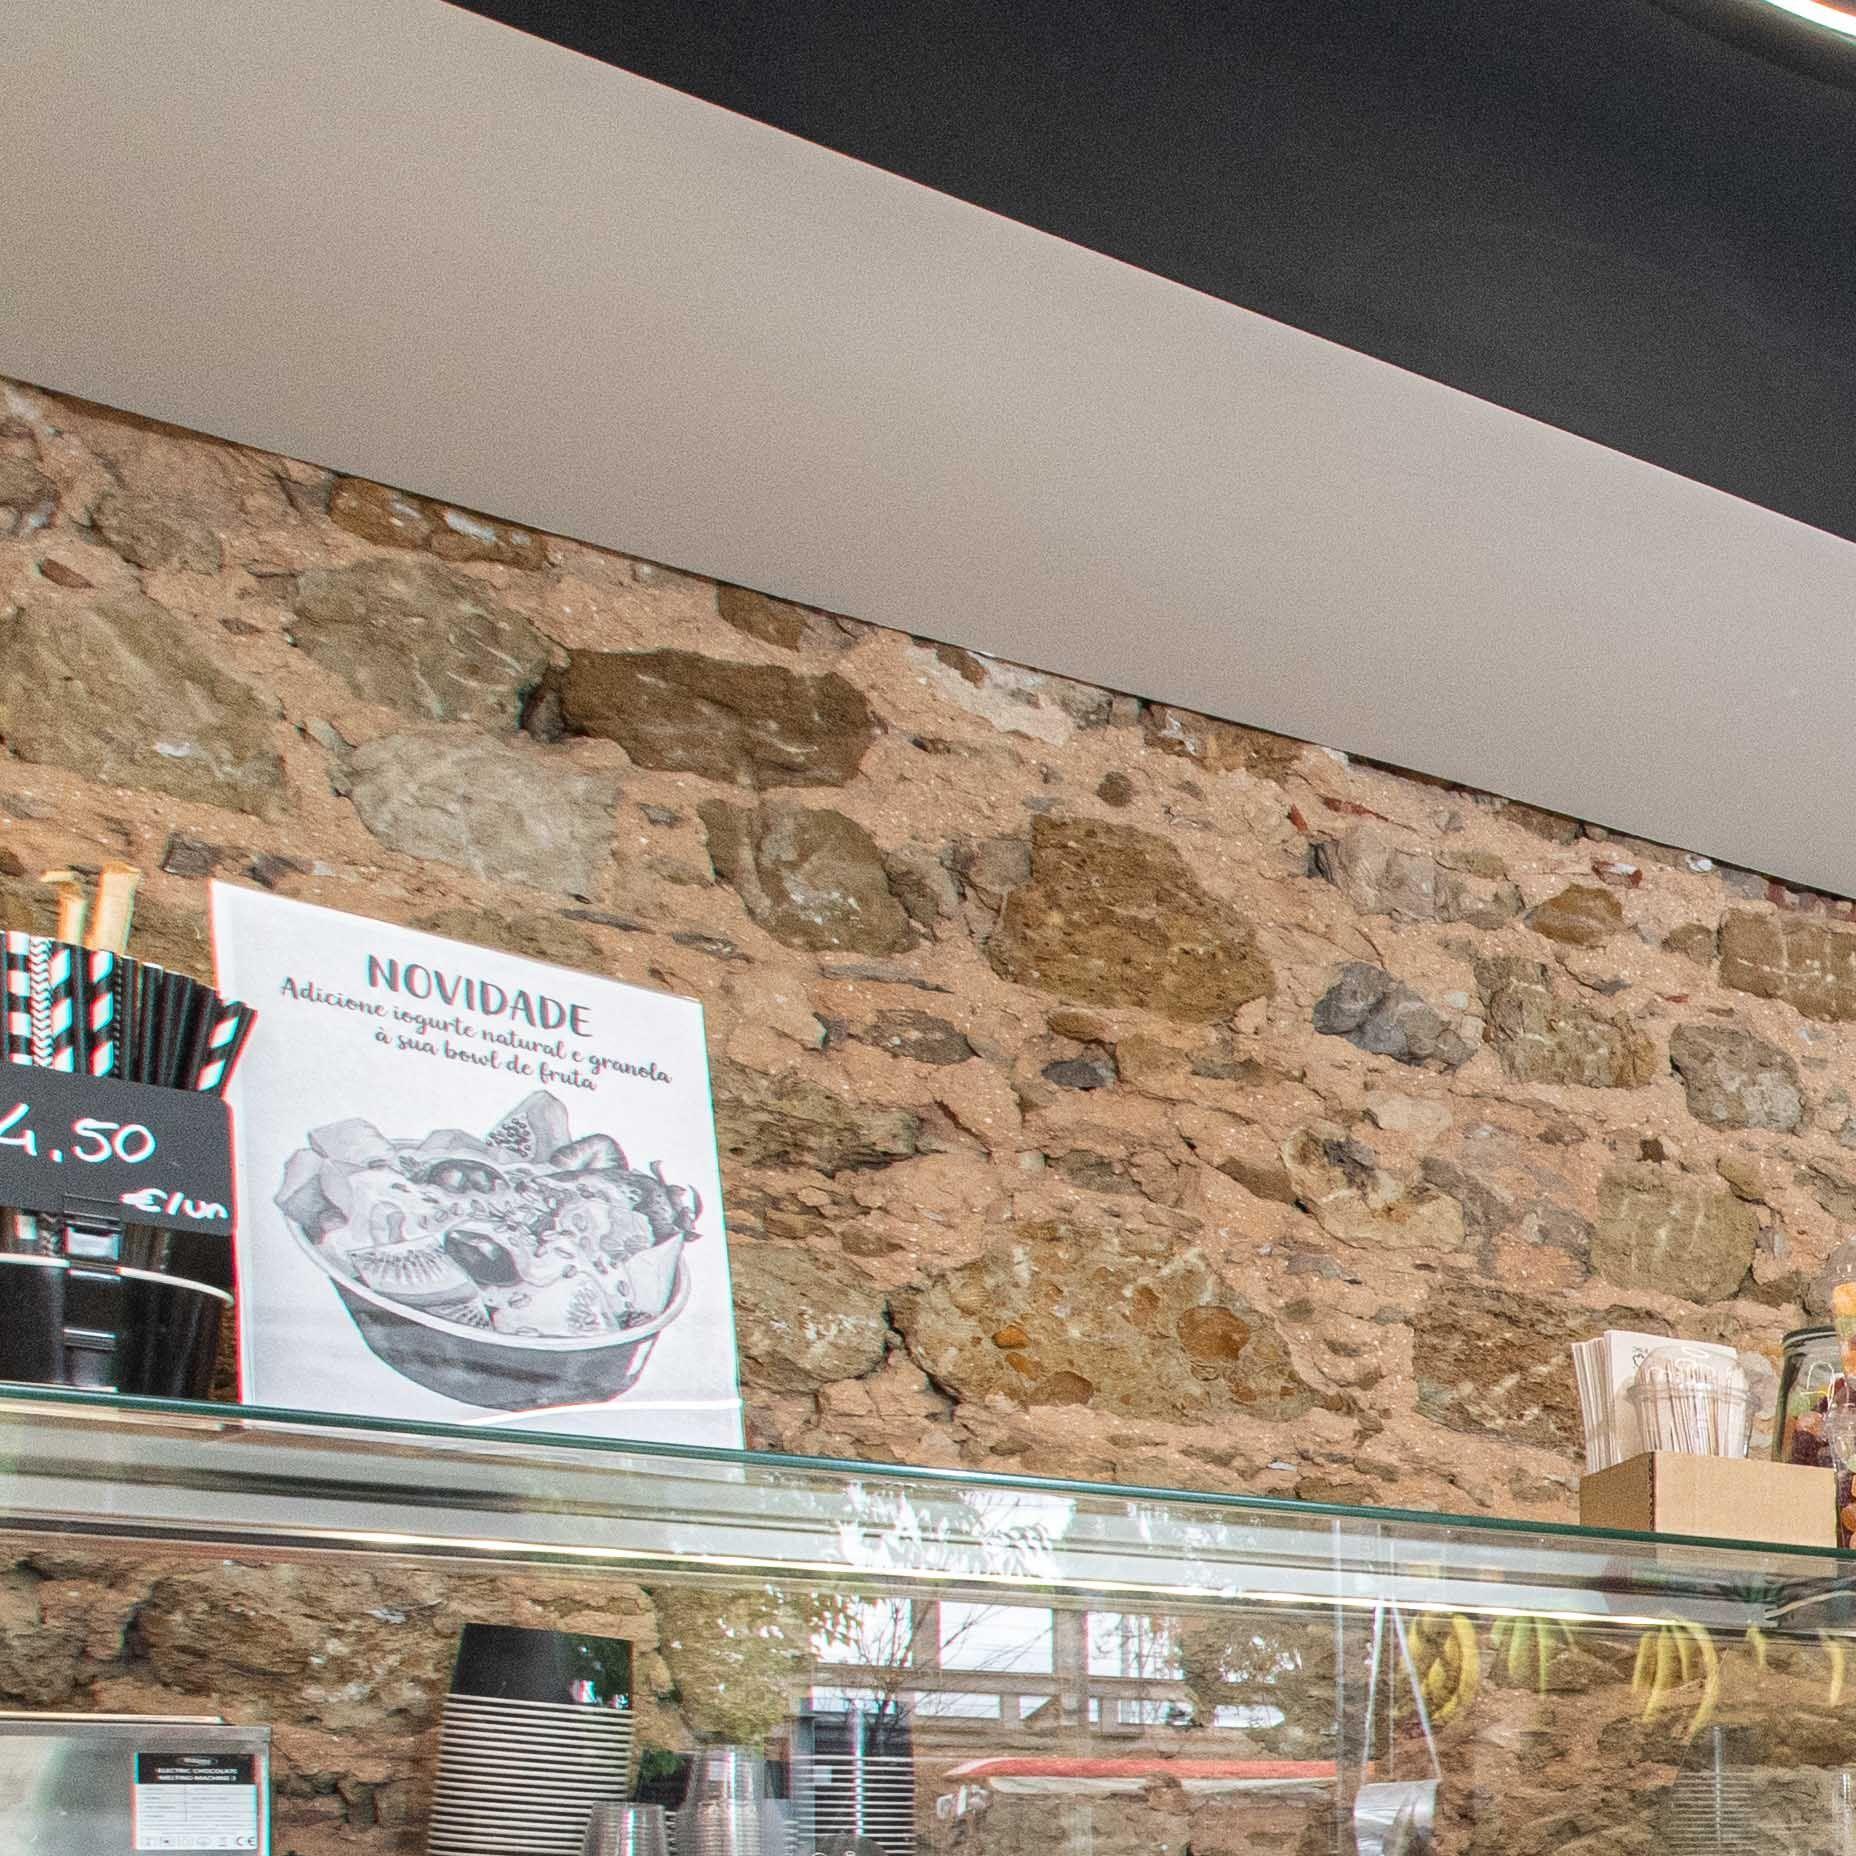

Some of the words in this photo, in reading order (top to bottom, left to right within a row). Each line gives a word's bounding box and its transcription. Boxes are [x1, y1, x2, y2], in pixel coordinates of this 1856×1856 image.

[281, 976, 387, 1018] Adicione
[393, 1007, 475, 1038] iogurte
[481, 1023, 566, 1060] natural
[572, 1051, 584, 1063] e
[589, 1053, 673, 1084] granola
[368, 954, 593, 1037] NOVIDADE
[374, 1026, 391, 1045] à
[397, 1035, 436, 1056] sua
[444, 1040, 501, 1069] bowl
[506, 1055, 534, 1077] de
[539, 1061, 598, 1091] fruta
[119, 1187, 229, 1219] €/un
